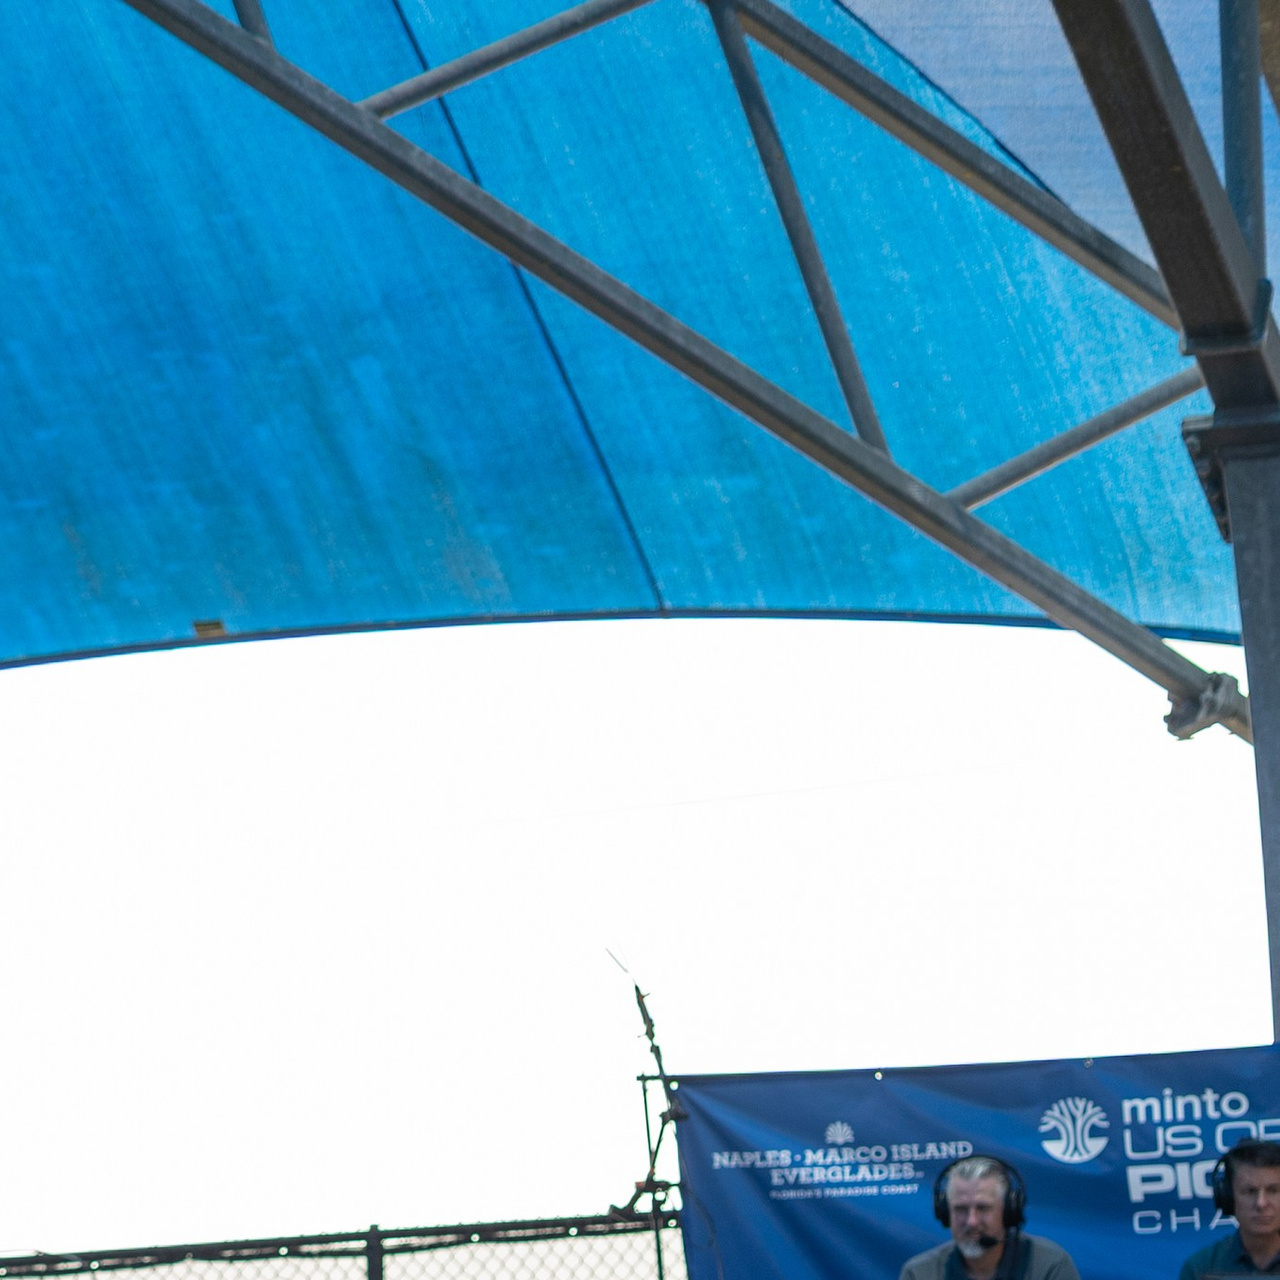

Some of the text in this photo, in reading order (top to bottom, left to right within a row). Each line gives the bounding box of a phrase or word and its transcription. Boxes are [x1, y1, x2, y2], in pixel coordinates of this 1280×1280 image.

[1122, 1087, 1250, 1125] minto
[712, 1140, 973, 1169] NAPLES MARCO ISLAND
[1123, 1124, 1203, 1160] US
[770, 1162, 915, 1186] EVERGLADES
